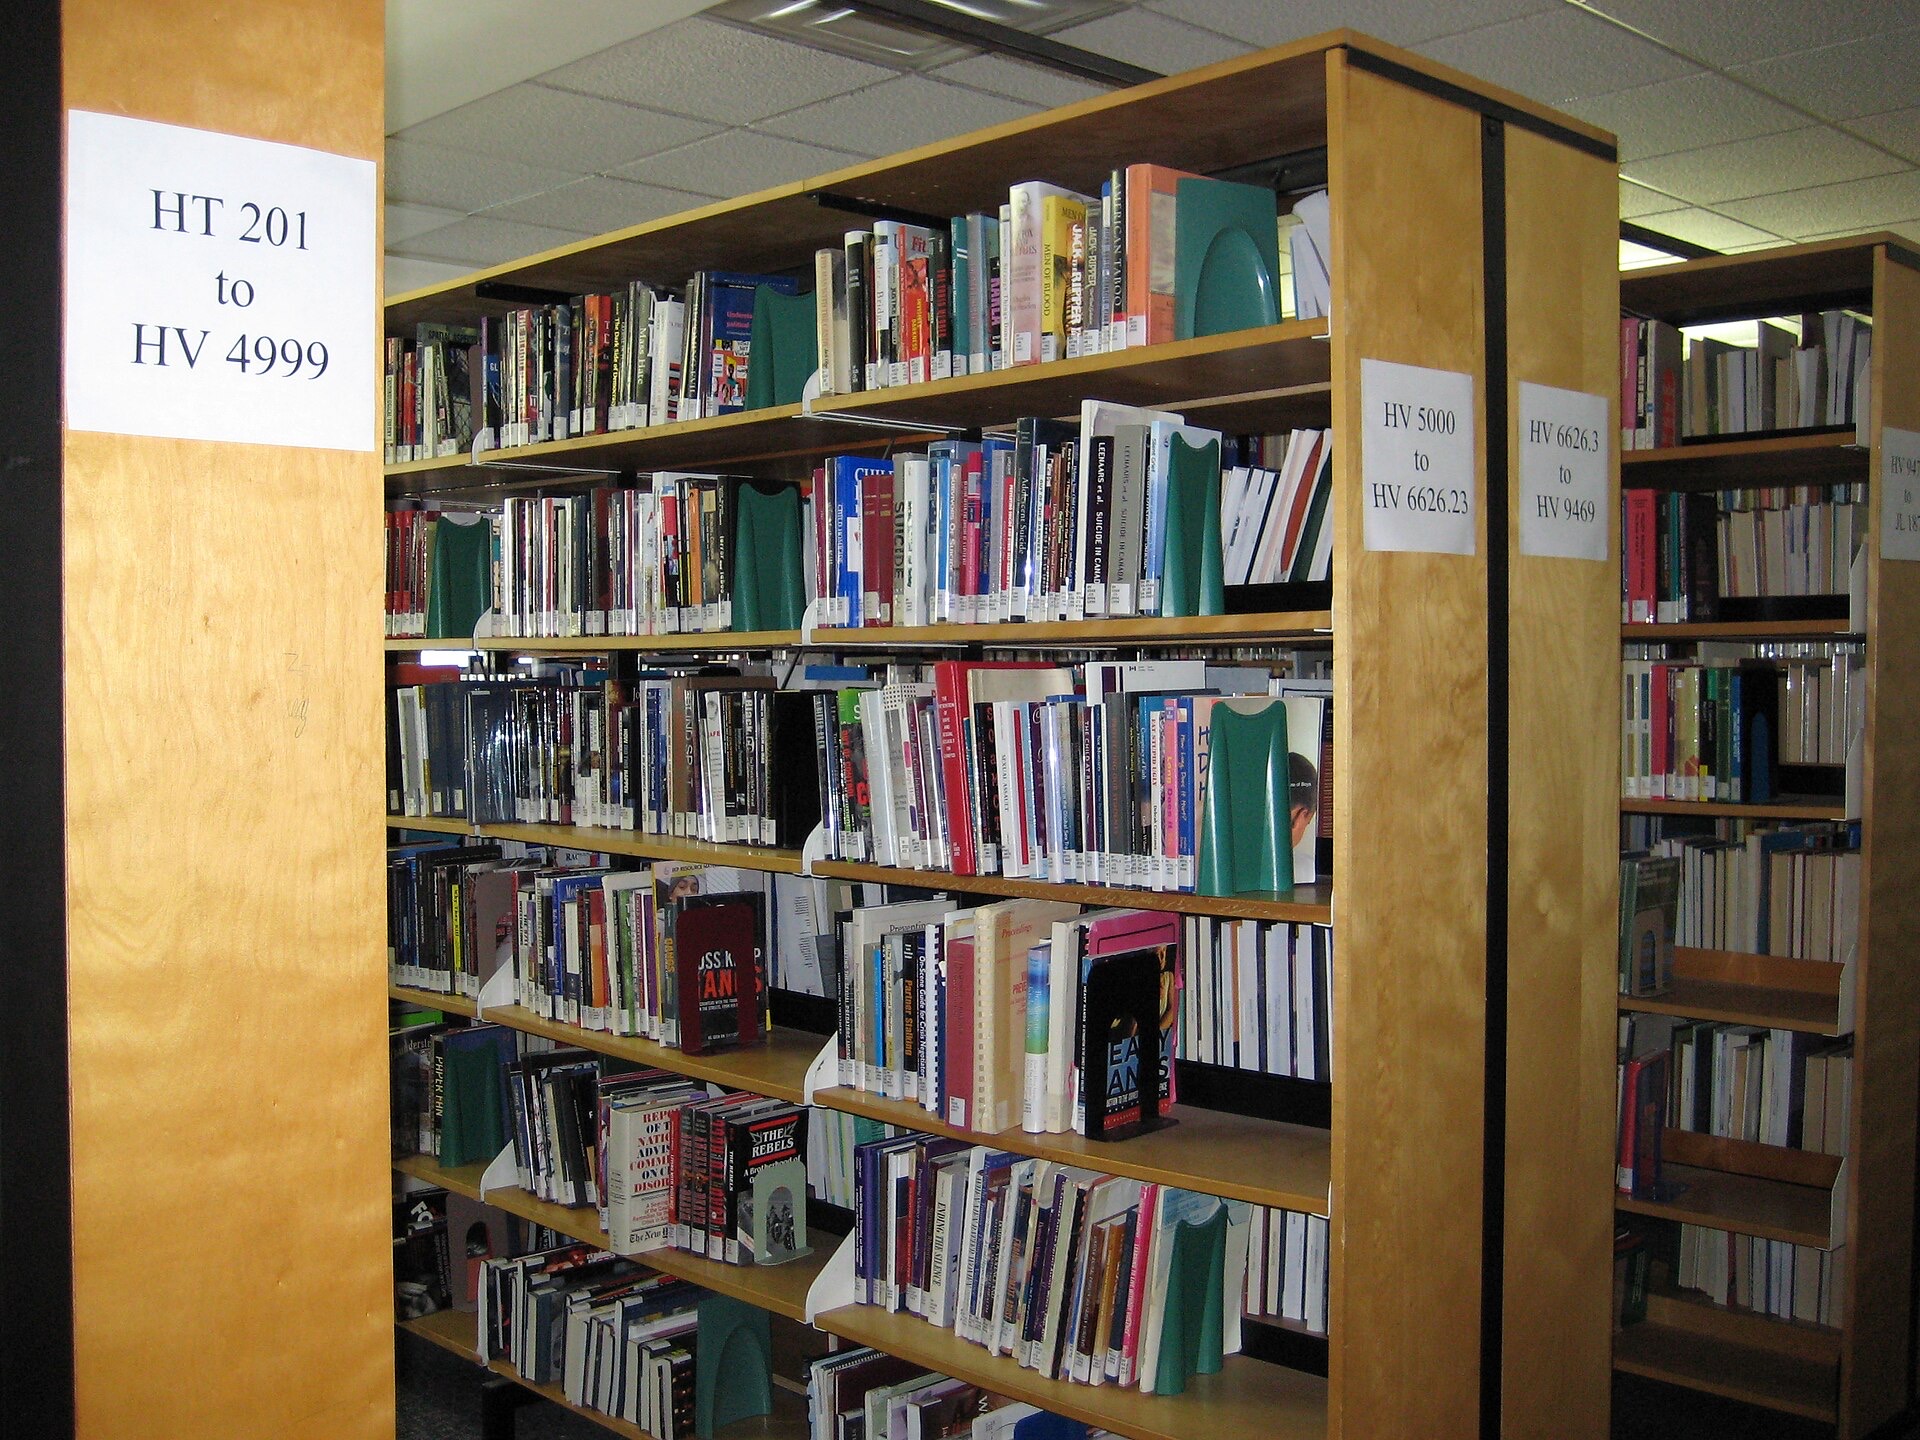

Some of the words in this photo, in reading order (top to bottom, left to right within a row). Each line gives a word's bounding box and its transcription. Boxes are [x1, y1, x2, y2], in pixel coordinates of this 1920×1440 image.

[149, 188, 224, 237] HT
[239, 202, 309, 250] 201
[1113, 182, 1122, 255] AMERICAN
[1043, 244, 1051, 265] MEN
[1071, 224, 1083, 258] JACK
[1088, 227, 1098, 251] JACK
[1044, 268, 1051, 281] OF
[1085, 255, 1097, 289] RIPPER
[1113, 259, 1122, 306] TABOO
[215, 270, 255, 307] to
[991, 277, 1001, 326] KARLA
[1043, 284, 1051, 316] BLOOD
[1070, 271, 1083, 324] RIPPER
[131, 323, 211, 369] HV
[226, 334, 329, 379] 4999
[612, 332, 620, 347] Dark
[638, 328, 646, 357] Mass
[612, 348, 620, 363] Side
[637, 359, 645, 385] Hate
[610, 372, 619, 407] Democracy
[1384, 402, 1411, 430] HV
[1418, 407, 1456, 435] 5000
[1530, 419, 1553, 445] HV
[1556, 424, 1599, 452] 6626.3
[1097, 442, 1106, 483] LEENAARS
[1123, 446, 1131, 483] LEENAARS
[1414, 449, 1429, 472] to
[1559, 464, 1572, 485] to
[1018, 477, 1029, 522] Adolescent
[1096, 495, 1104, 505] al.
[1097, 485, 1103, 493] et
[1372, 483, 1401, 509] HV
[1407, 486, 1469, 514] 6626.23
[1120, 508, 1128, 539] SUICIDE
[1537, 495, 1560, 519] HV
[1564, 499, 1595, 523] 9469
[894, 502, 904, 579] SUICIDE
[1018, 524, 1028, 555] Suicide
[1095, 511, 1104, 544] SUICIDE
[1095, 547, 1103, 556] IN
[1119, 541, 1126, 550] IN
[1094, 558, 1103, 583] CANAD
[1117, 552, 1126, 581] CANADA
[841, 730, 849, 746] OUT
[843, 748, 850, 759] OF
[844, 761, 854, 797] CONTROL
[1085, 763, 1090, 773] AT
[890, 921, 926, 933] Preventin
[665, 937, 675, 973] GANGS
[918, 956, 926, 987] On-Scene
[905, 979, 913, 1015] Partner
[905, 1018, 913, 1056] Stalking
[435, 1056, 443, 1092] PAPER
[646, 1122, 661, 1134] OF
[763, 1127, 784, 1143] THE
[752, 1138, 794, 1159] REBELS
[641, 1168, 659, 1181] ON
[974, 1176, 983, 1202] WHEN
[936, 1202, 946, 1233] ENDING
[972, 1204, 981, 1222] MEN
[629, 1231, 644, 1243] The
[644, 1230, 661, 1241] New
[935, 1235, 944, 1251] THE
[968, 1224, 979, 1254] BATTER
[932, 1252, 942, 1287] SILENCE
[966, 1256, 976, 1288] WOMEN
